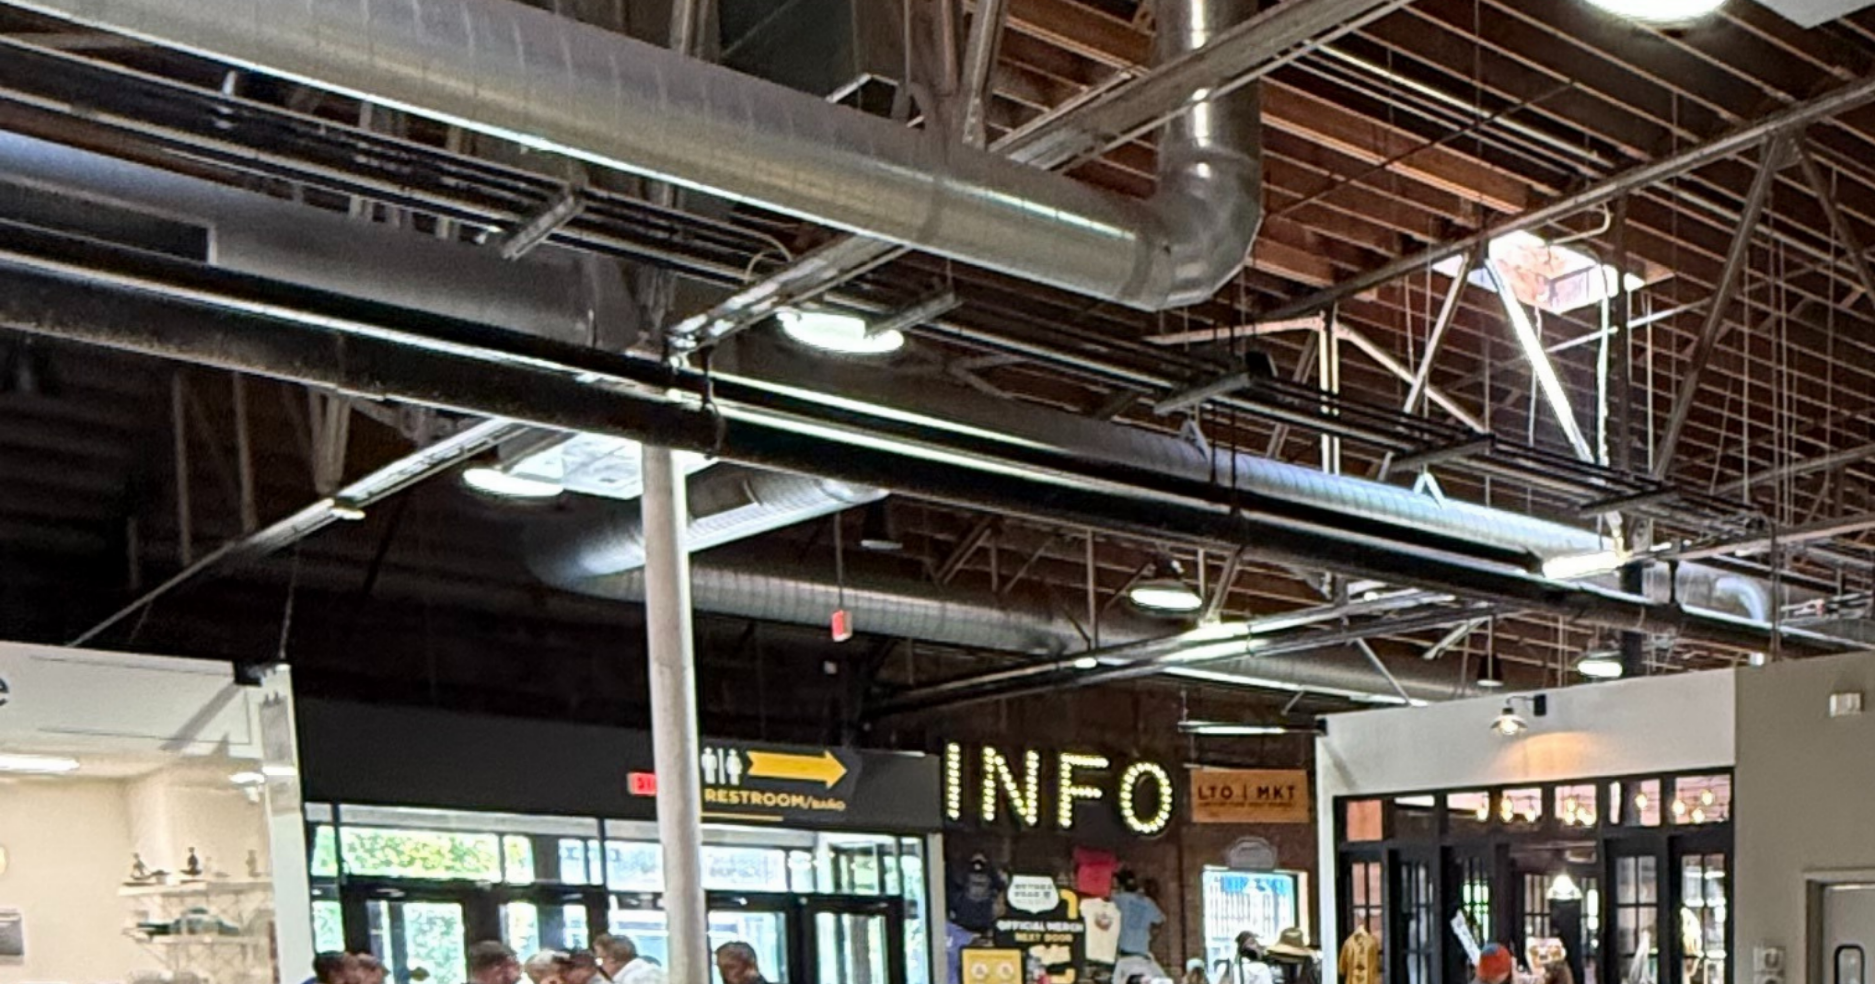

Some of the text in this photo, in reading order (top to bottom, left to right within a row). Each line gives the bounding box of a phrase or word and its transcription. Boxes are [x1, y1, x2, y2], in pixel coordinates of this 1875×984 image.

[947, 743, 1172, 833] INFO
[1198, 786, 1296, 800] LTO MKT
